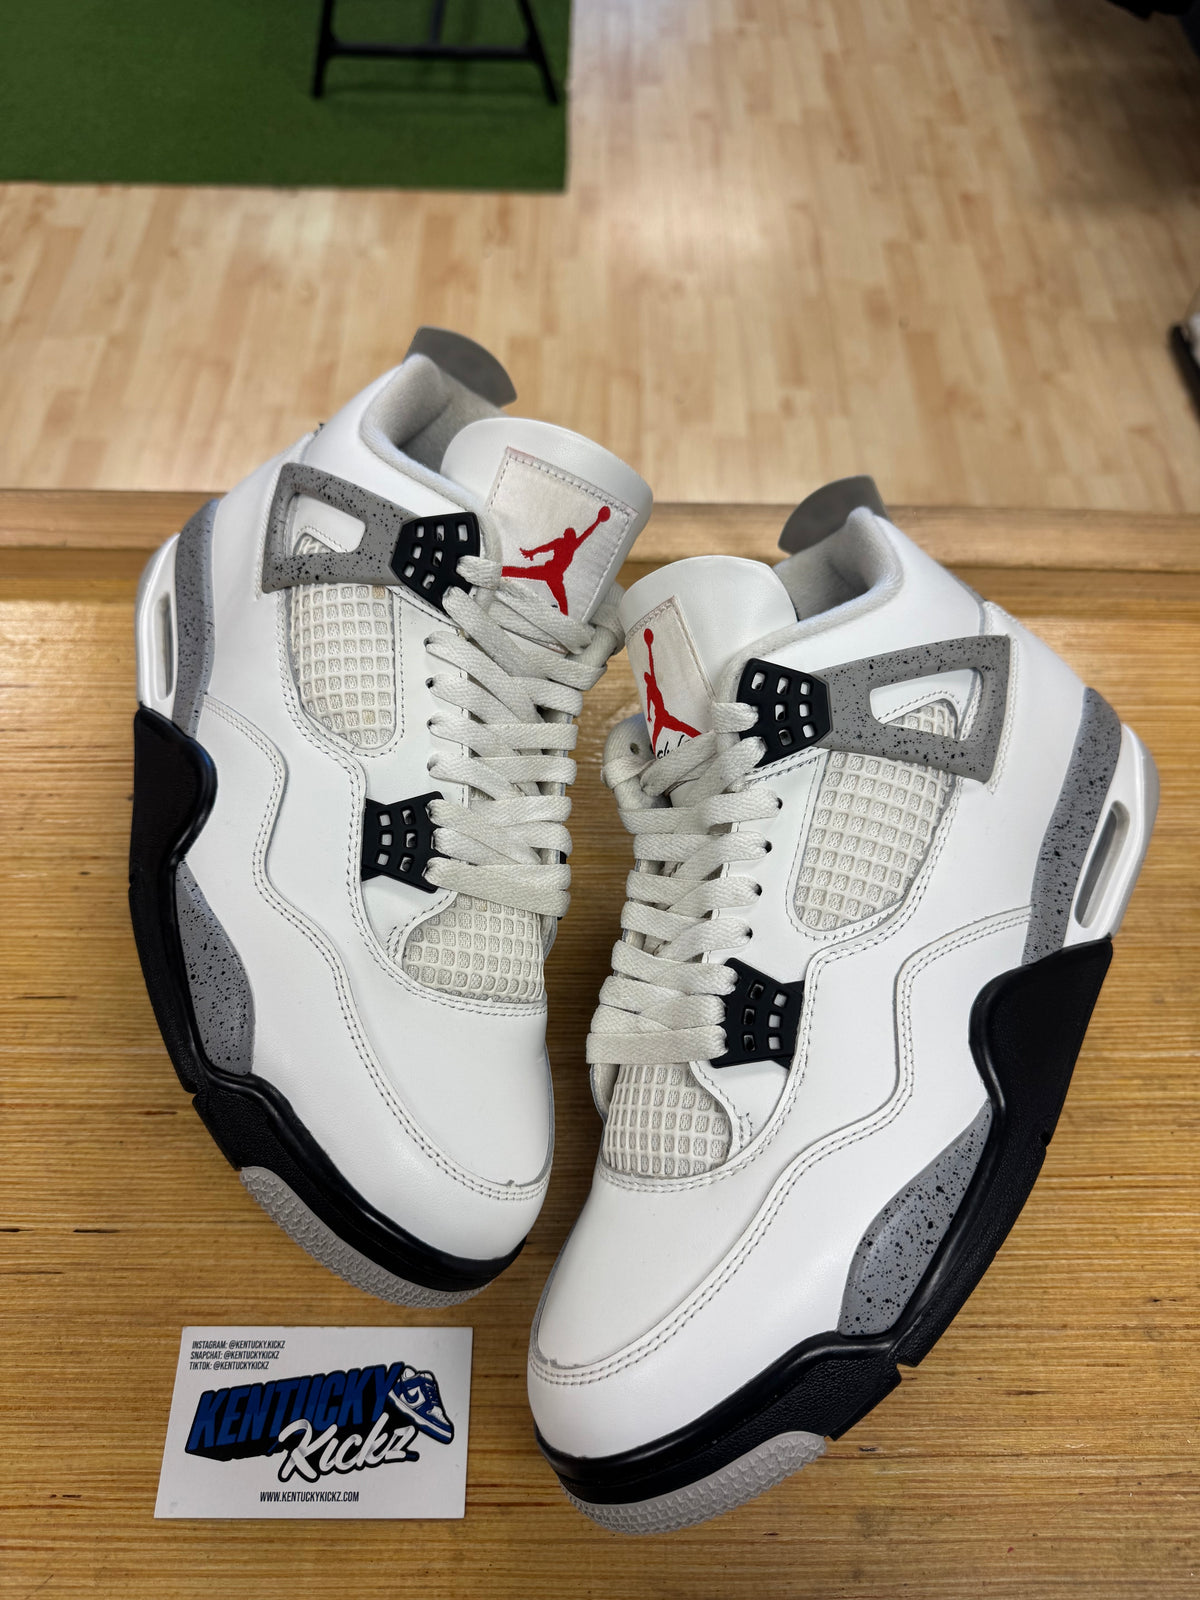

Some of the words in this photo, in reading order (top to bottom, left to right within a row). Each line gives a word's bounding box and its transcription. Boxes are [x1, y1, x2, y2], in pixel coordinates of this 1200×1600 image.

[191, 1340, 228, 1349] INSTAGRAM:
[228, 1340, 286, 1350] @KENTUCKY.KICKZ
[190, 1351, 223, 1360] SNAPCHAT:
[223, 1351, 280, 1360] @KENTUCKYKICKZ
[189, 1361, 213, 1370] TIKTOK:
[213, 1361, 270, 1371] @KENTUCKYKICKZ
[186, 1362, 405, 1453] KENTUCKY
[278, 1412, 417, 1480] Kickz
[259, 1491, 360, 1503] WWW.KENTUCKYKICKZ.COM
